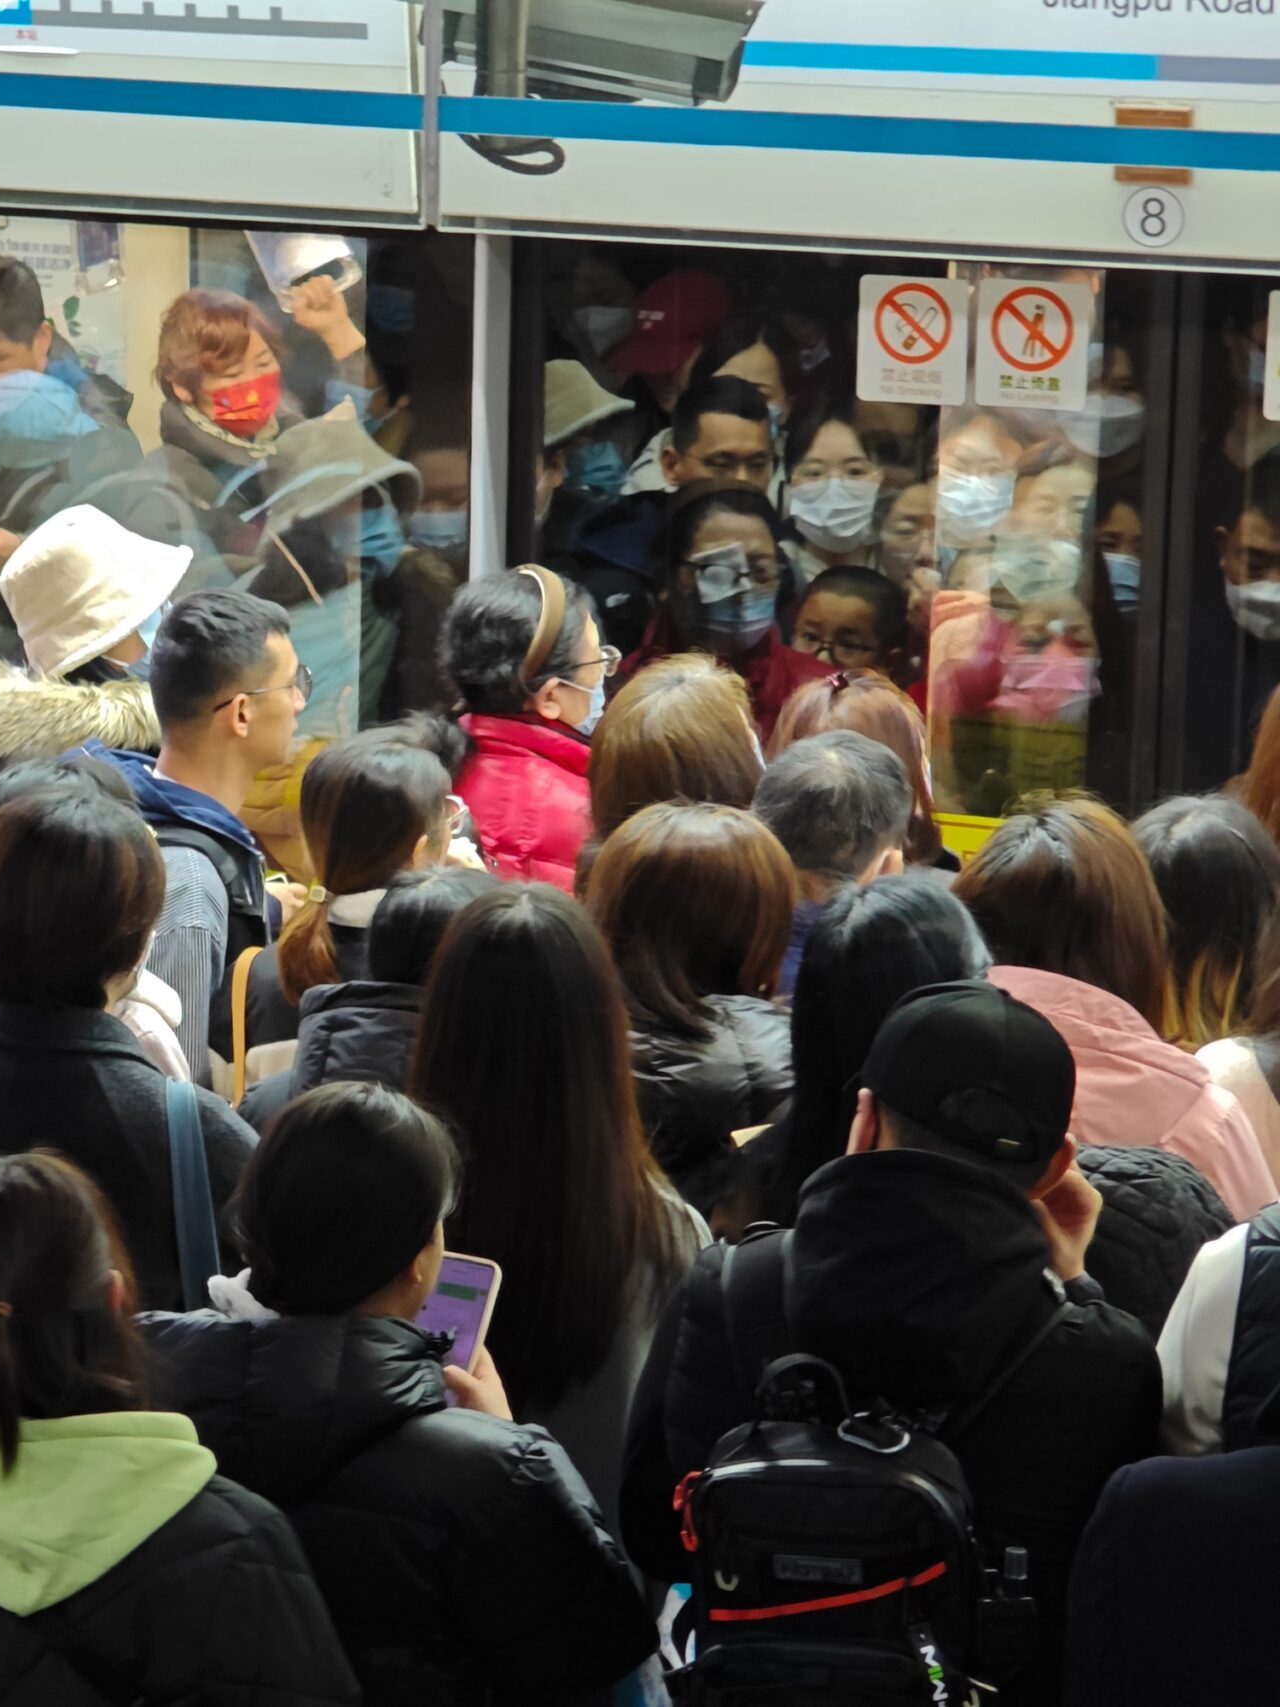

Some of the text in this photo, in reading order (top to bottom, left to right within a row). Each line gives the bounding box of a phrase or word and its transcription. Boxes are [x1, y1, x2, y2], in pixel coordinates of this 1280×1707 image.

[1139, 197, 1167, 237] 8
[880, 367, 942, 385] 禁止吸烟
